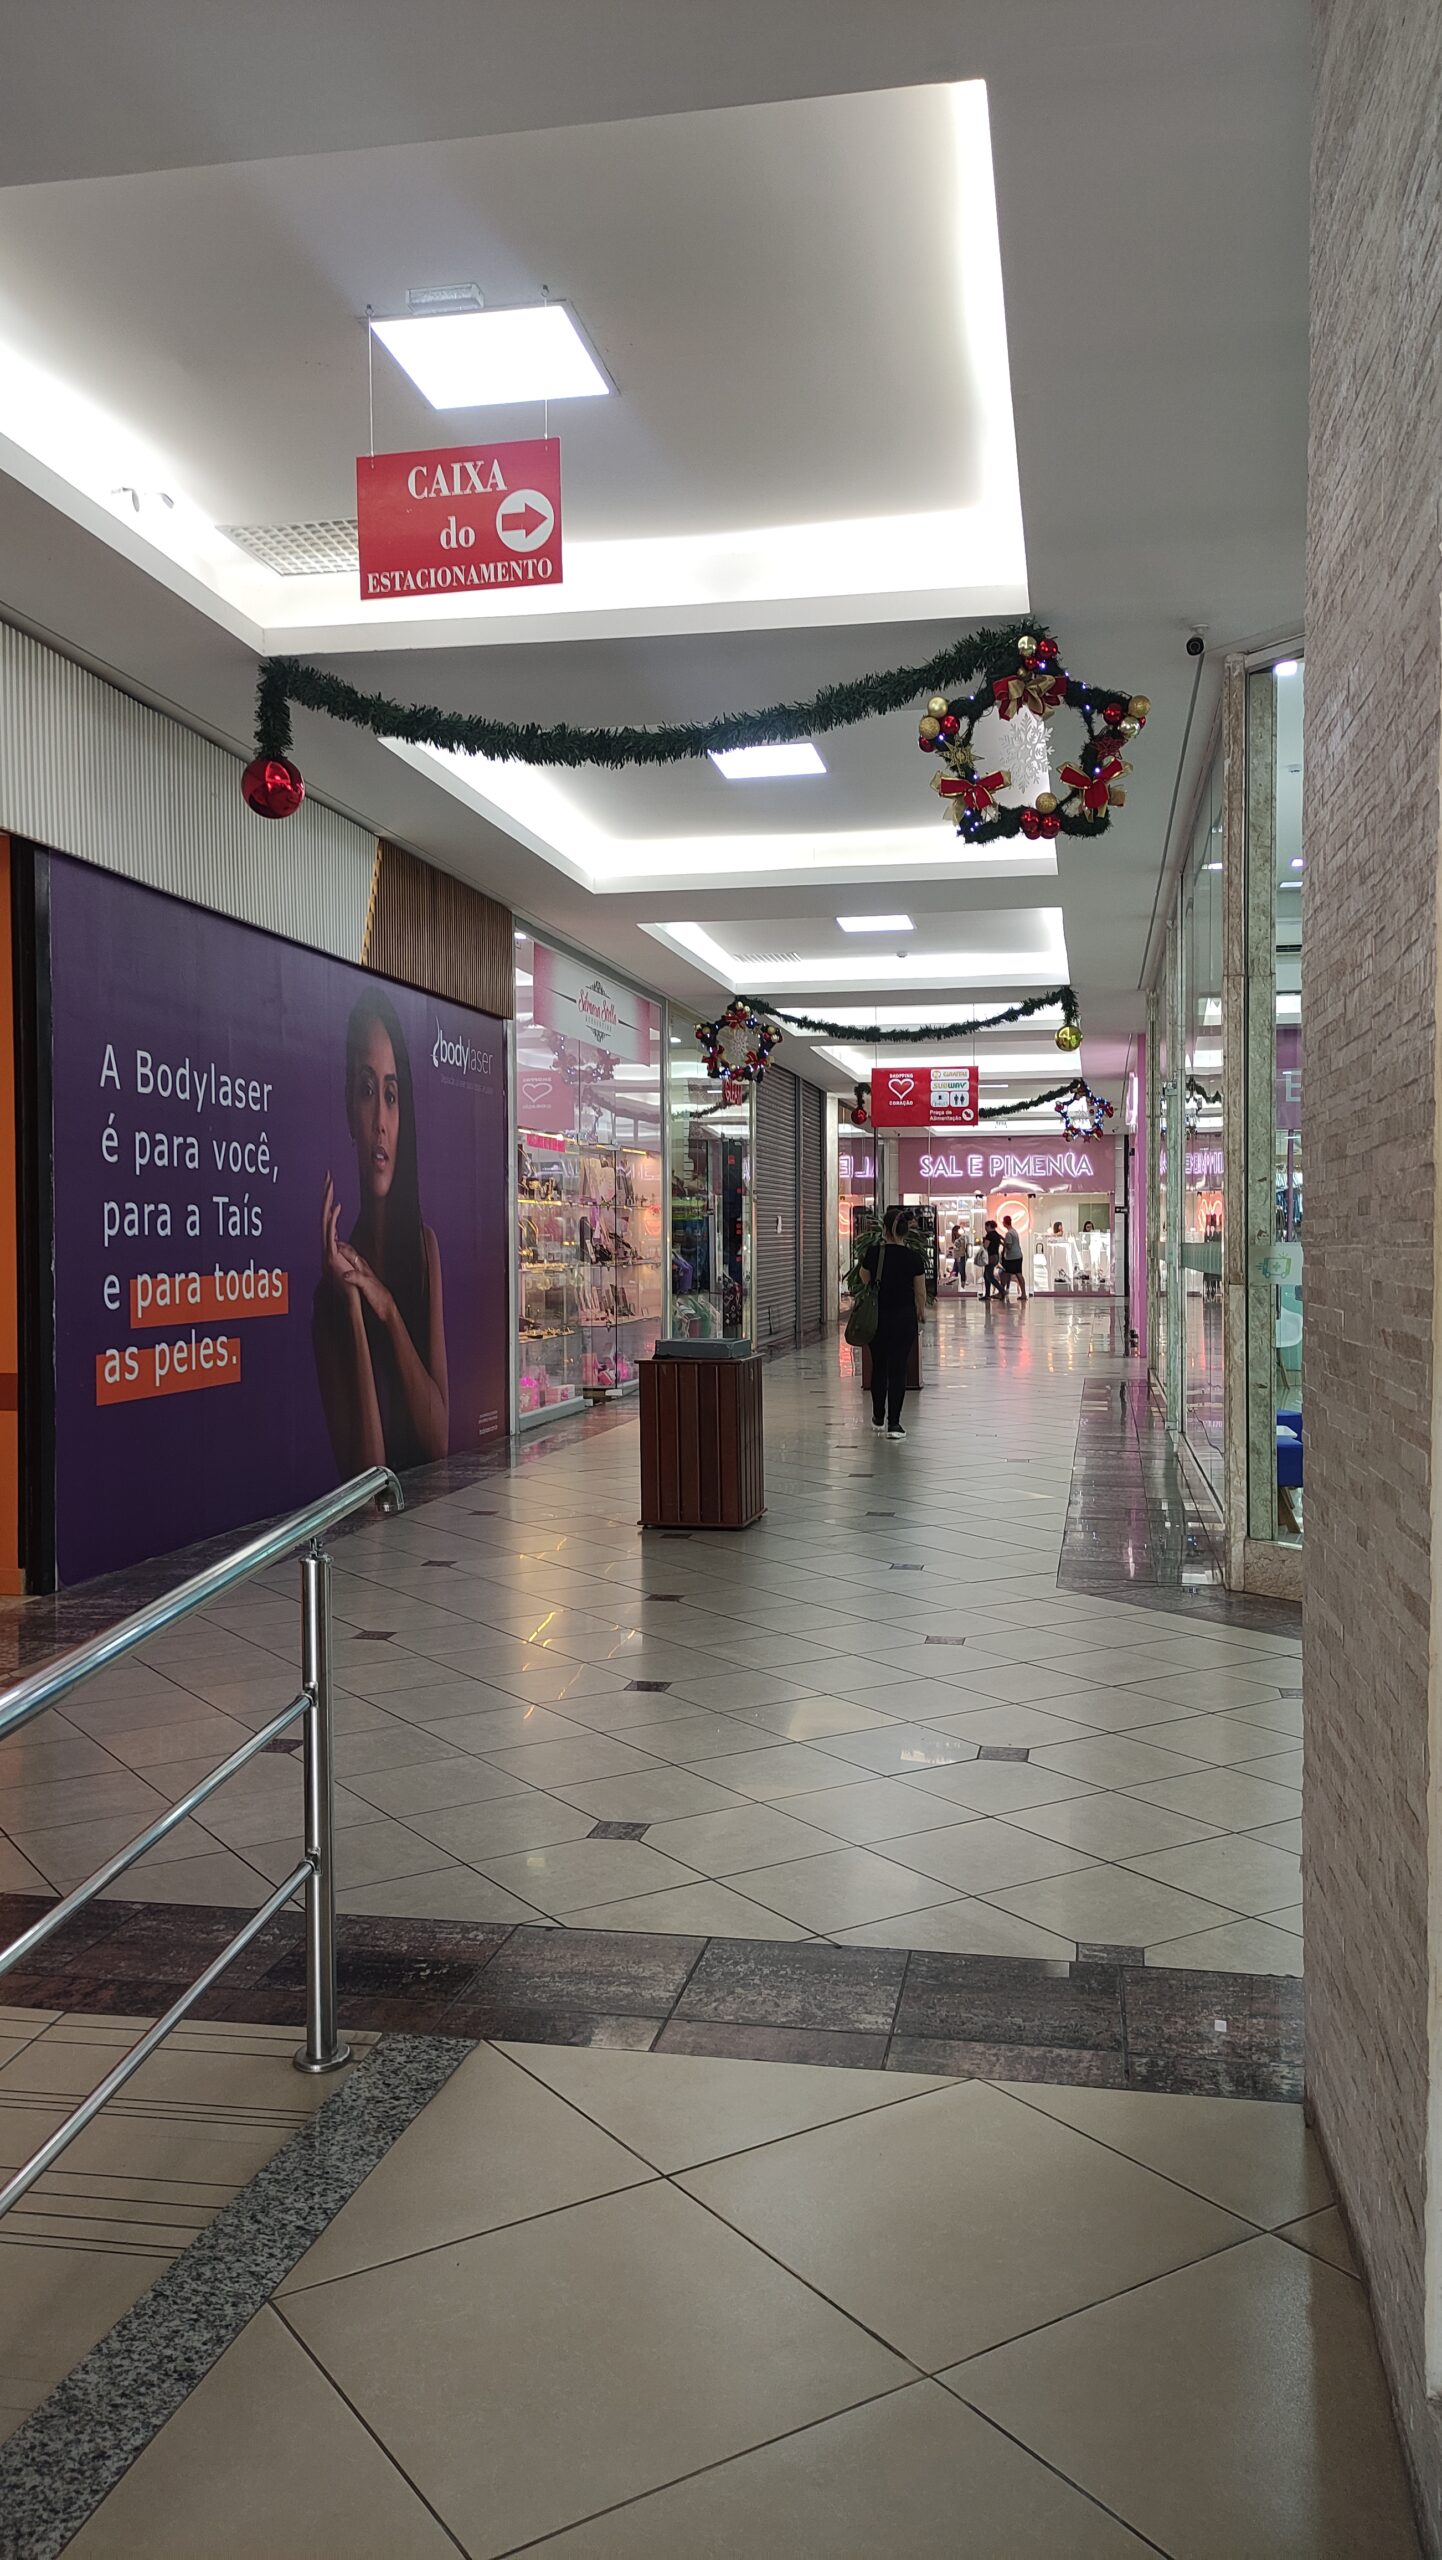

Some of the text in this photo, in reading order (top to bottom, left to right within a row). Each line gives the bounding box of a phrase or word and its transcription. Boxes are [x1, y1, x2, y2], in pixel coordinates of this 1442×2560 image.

[407, 458, 508, 500] CAIXA
[439, 515, 476, 550] do
[367, 557, 553, 594] ESTACIONAMENTO
[440, 1029, 494, 1075] bodylaser
[99, 1043, 273, 1113] A Bodylaser
[102, 1112, 279, 1184] é para você,
[920, 1154, 963, 1178] SAL
[967, 1154, 984, 1178] E
[103, 1193, 263, 1247] para a Taís
[103, 1259, 283, 1319] e para todas
[103, 1328, 237, 1387] as peles.
